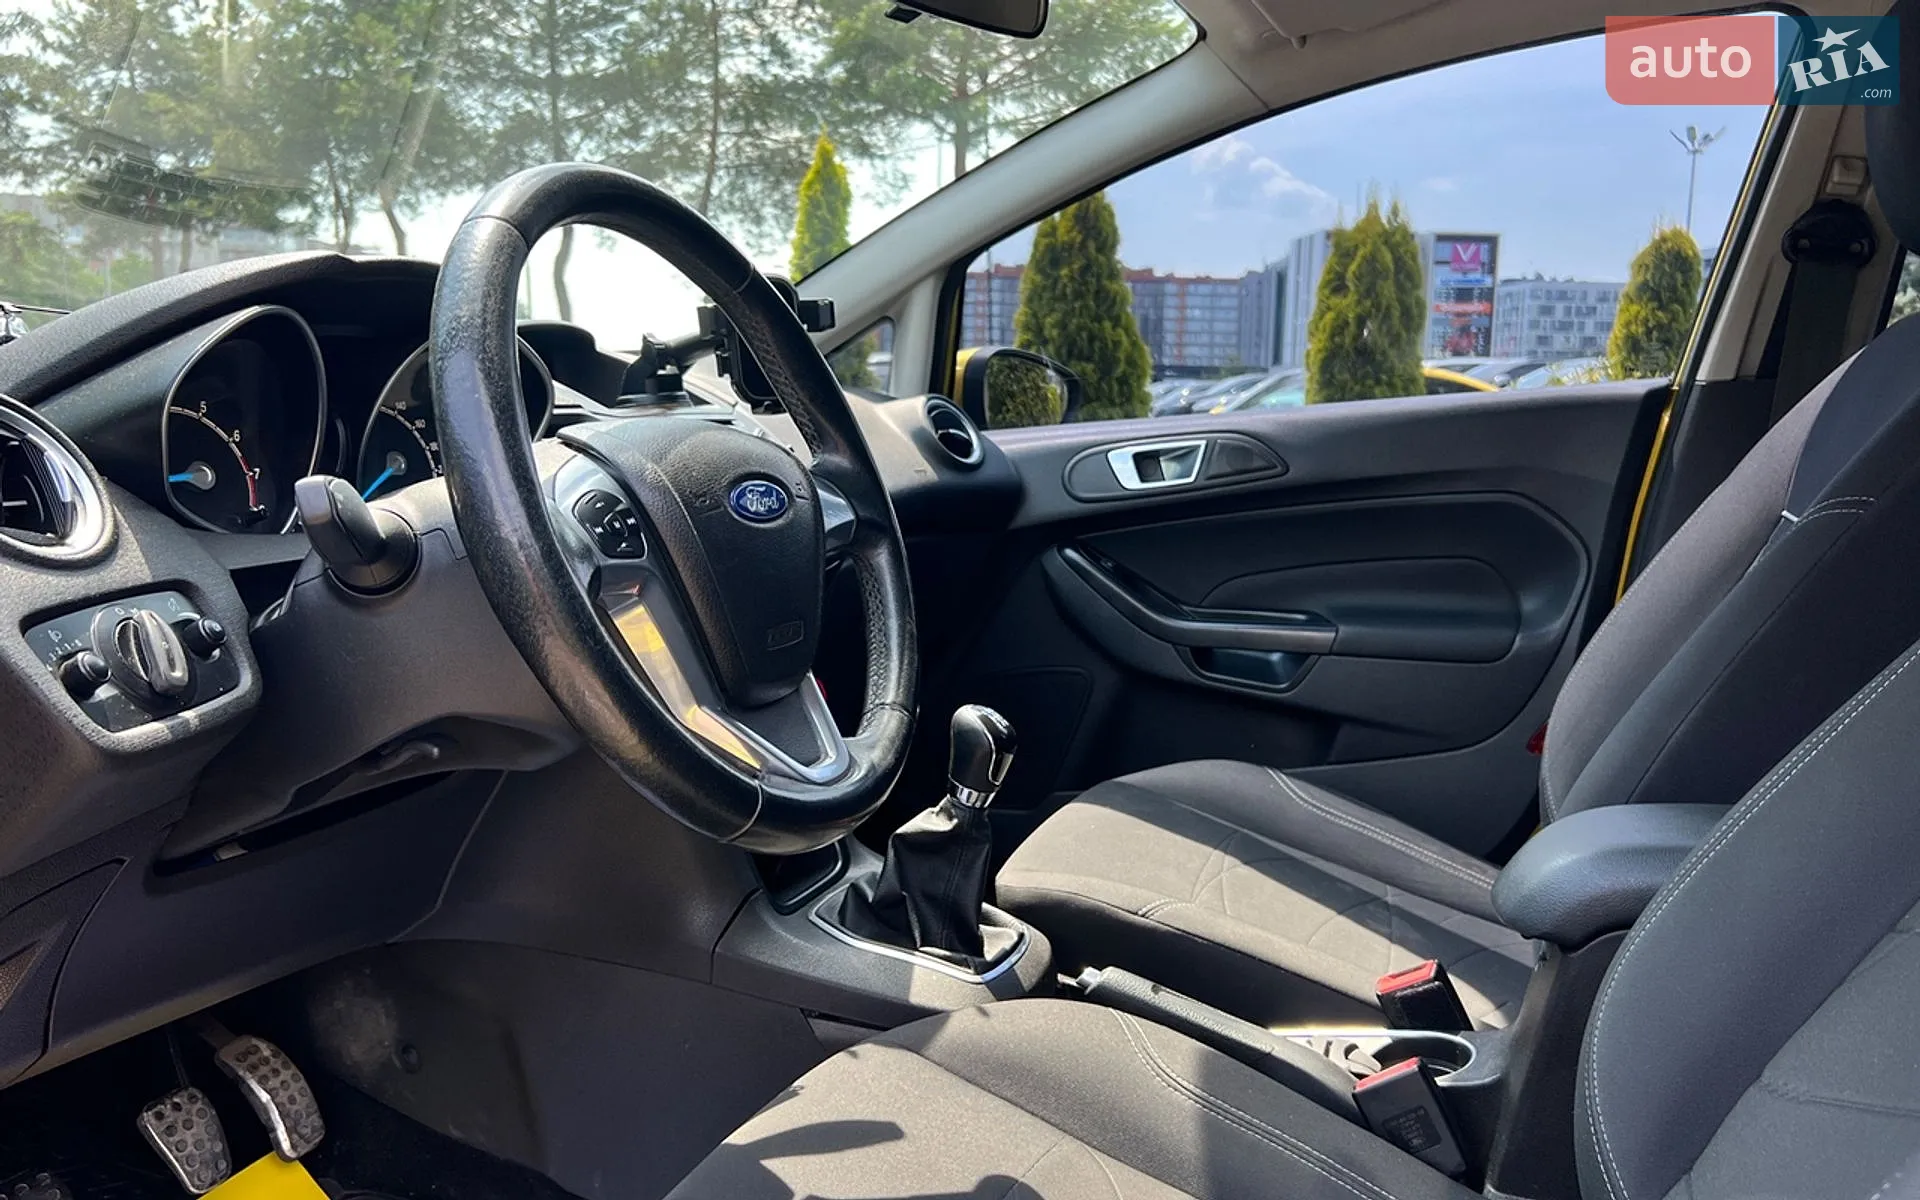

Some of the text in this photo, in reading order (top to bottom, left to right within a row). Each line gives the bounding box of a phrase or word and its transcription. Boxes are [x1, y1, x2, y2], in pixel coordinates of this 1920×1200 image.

[199, 400, 207, 413] 5
[233, 429, 241, 442] 6
[253, 468, 261, 479] 7
[745, 485, 780, 513] Ford
